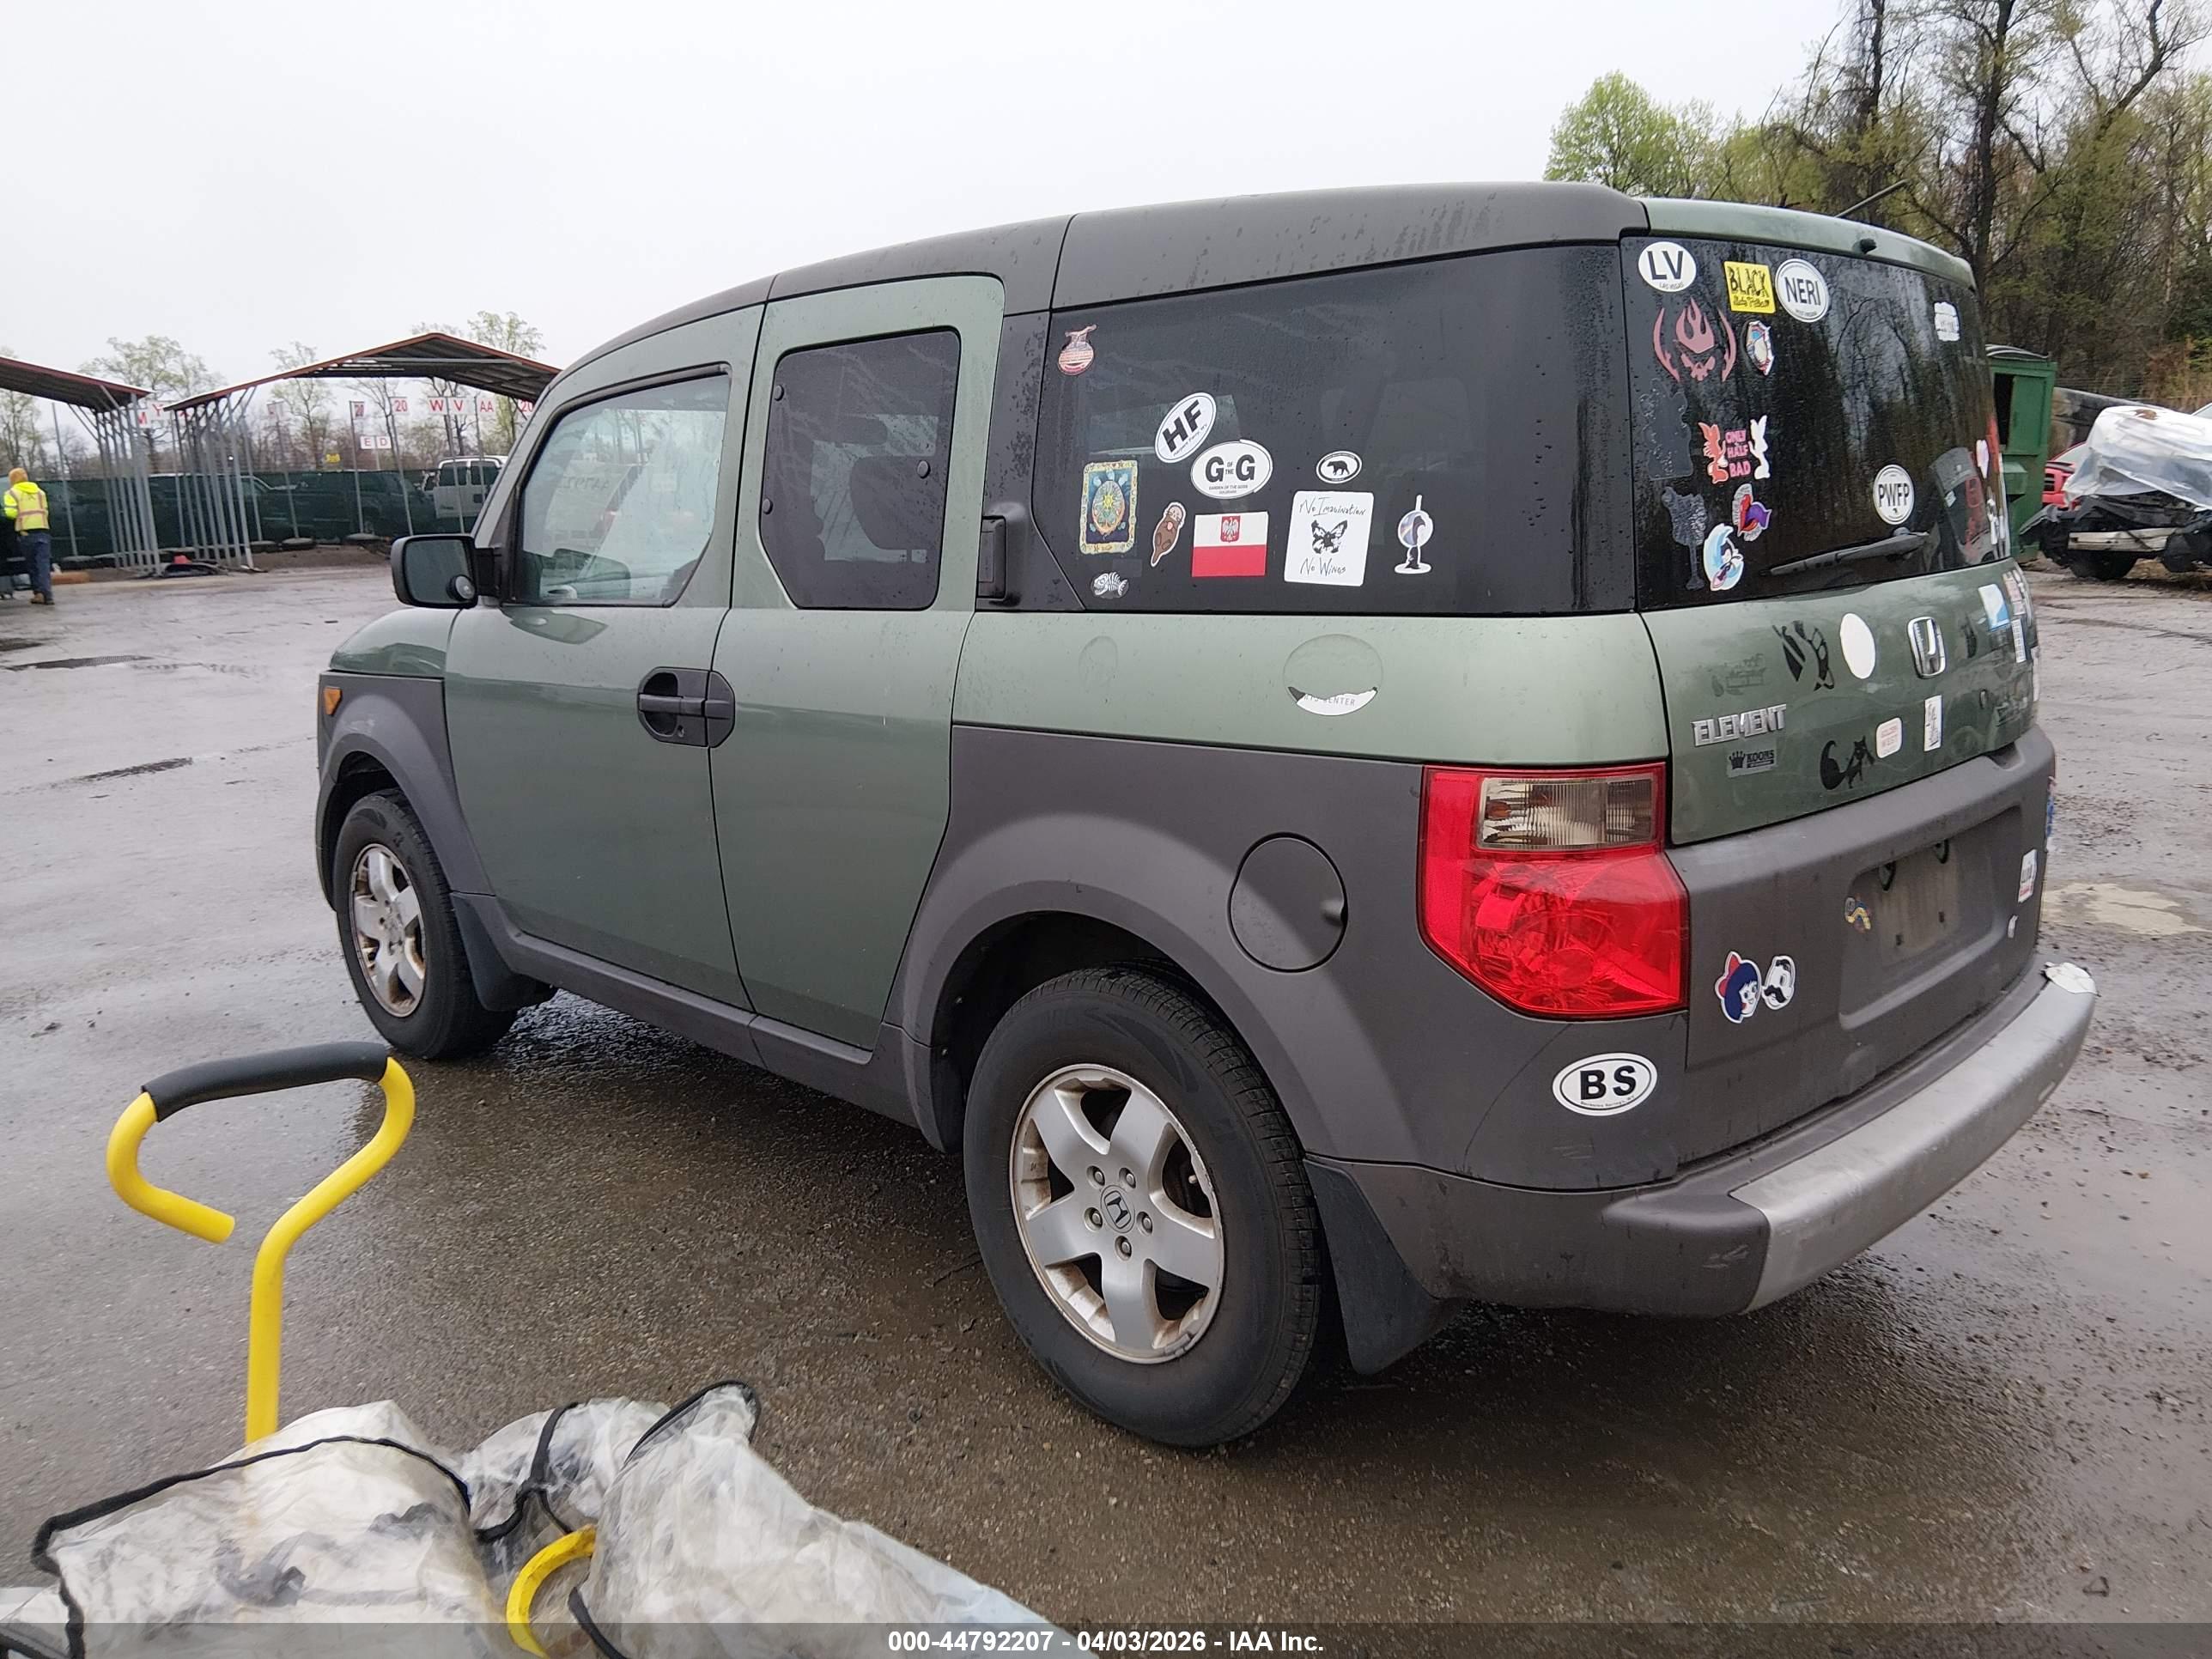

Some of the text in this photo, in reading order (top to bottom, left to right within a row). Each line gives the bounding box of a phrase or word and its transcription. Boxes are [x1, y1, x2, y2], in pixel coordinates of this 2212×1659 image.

[1646, 250, 1683, 280] LV
[1727, 266, 1769, 297] BLACK
[1784, 276, 1821, 306] NERI
[394, 399, 408, 412] 20
[429, 399, 444, 412] W
[453, 399, 464, 412] V
[479, 400, 495, 413] AA
[1162, 399, 1201, 453] HF
[363, 438, 372, 447] E
[380, 438, 388, 447] D
[1727, 445, 1748, 459] HALF
[1205, 456, 1224, 483] G
[1236, 454, 1255, 481] G
[1729, 460, 1751, 477] BAD
[1878, 483, 1911, 507] PWFP
[1299, 496, 1316, 514] No
[1300, 558, 1316, 575] No
[1690, 703, 1787, 747] ELEMENT
[1747, 750, 1774, 763] KOONS
[1580, 1065, 1637, 1101] BS
